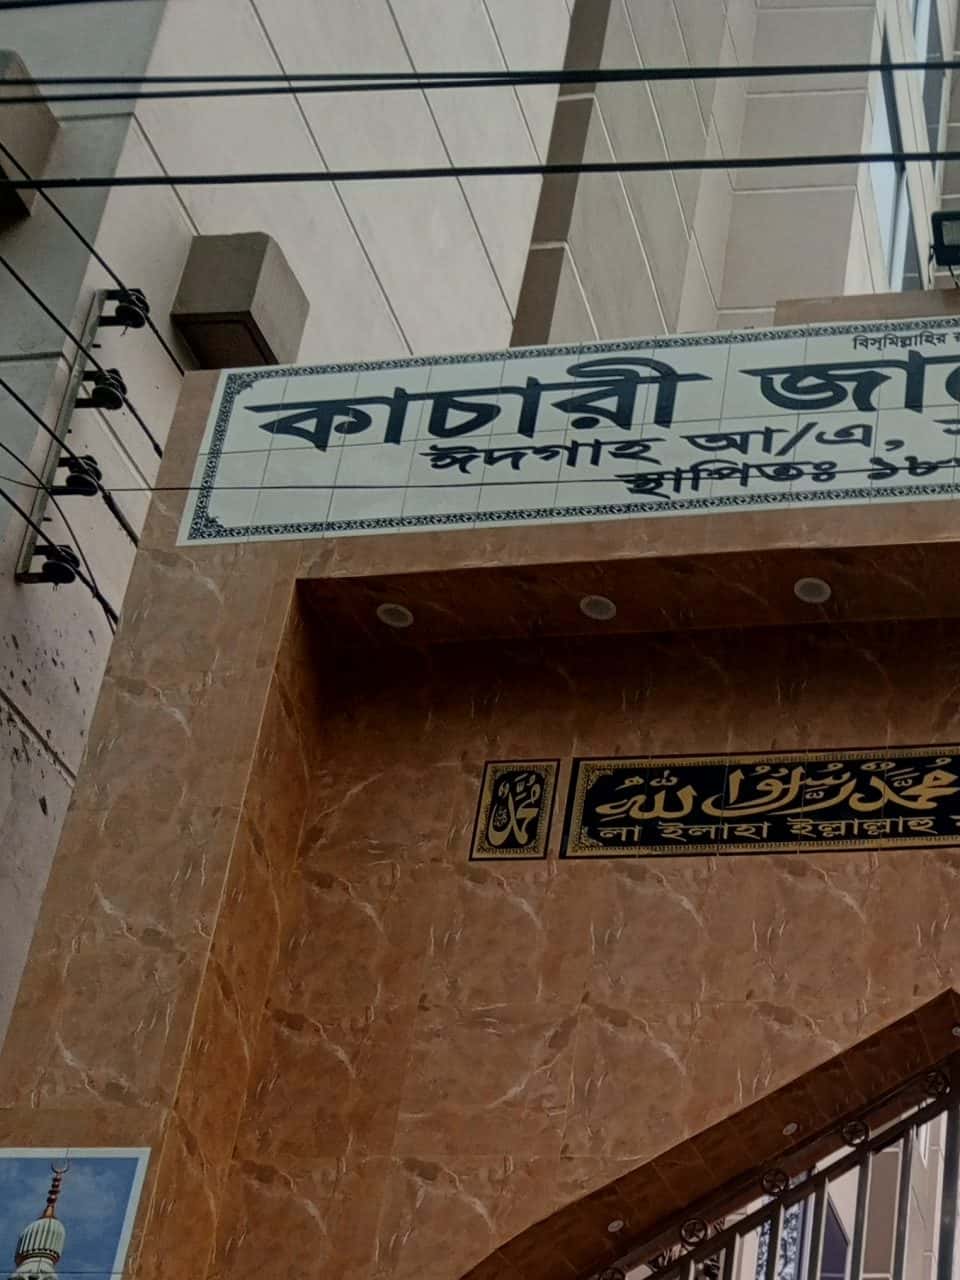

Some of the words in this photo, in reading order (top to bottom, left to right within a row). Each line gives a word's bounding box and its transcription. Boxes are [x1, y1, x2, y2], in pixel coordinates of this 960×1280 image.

[244, 356, 712, 452] কাচারী
[419, 437, 667, 474] ঈদগাহ
[595, 823, 643, 843] লা
[656, 819, 774, 842] ইলাহা
